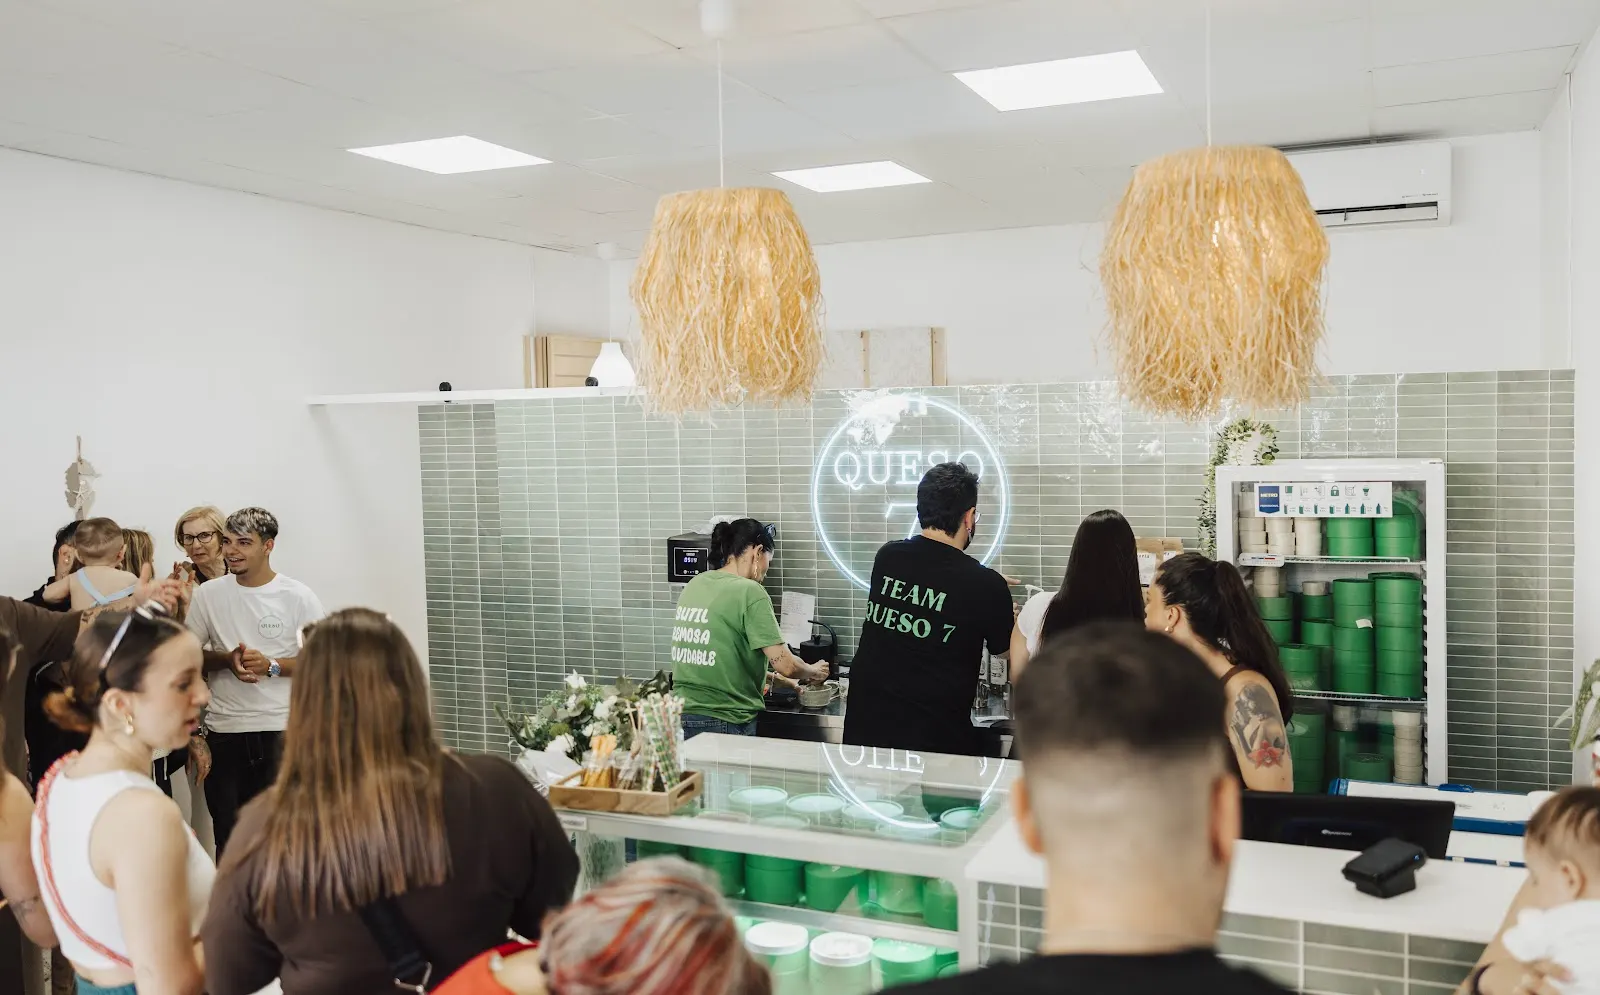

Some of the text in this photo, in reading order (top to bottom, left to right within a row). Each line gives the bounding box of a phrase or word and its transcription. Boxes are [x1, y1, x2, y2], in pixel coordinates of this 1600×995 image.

[881, 575, 947, 612] TEAM
[675, 605, 709, 624] SUTIL
[865, 600, 956, 643] QUESO 7
